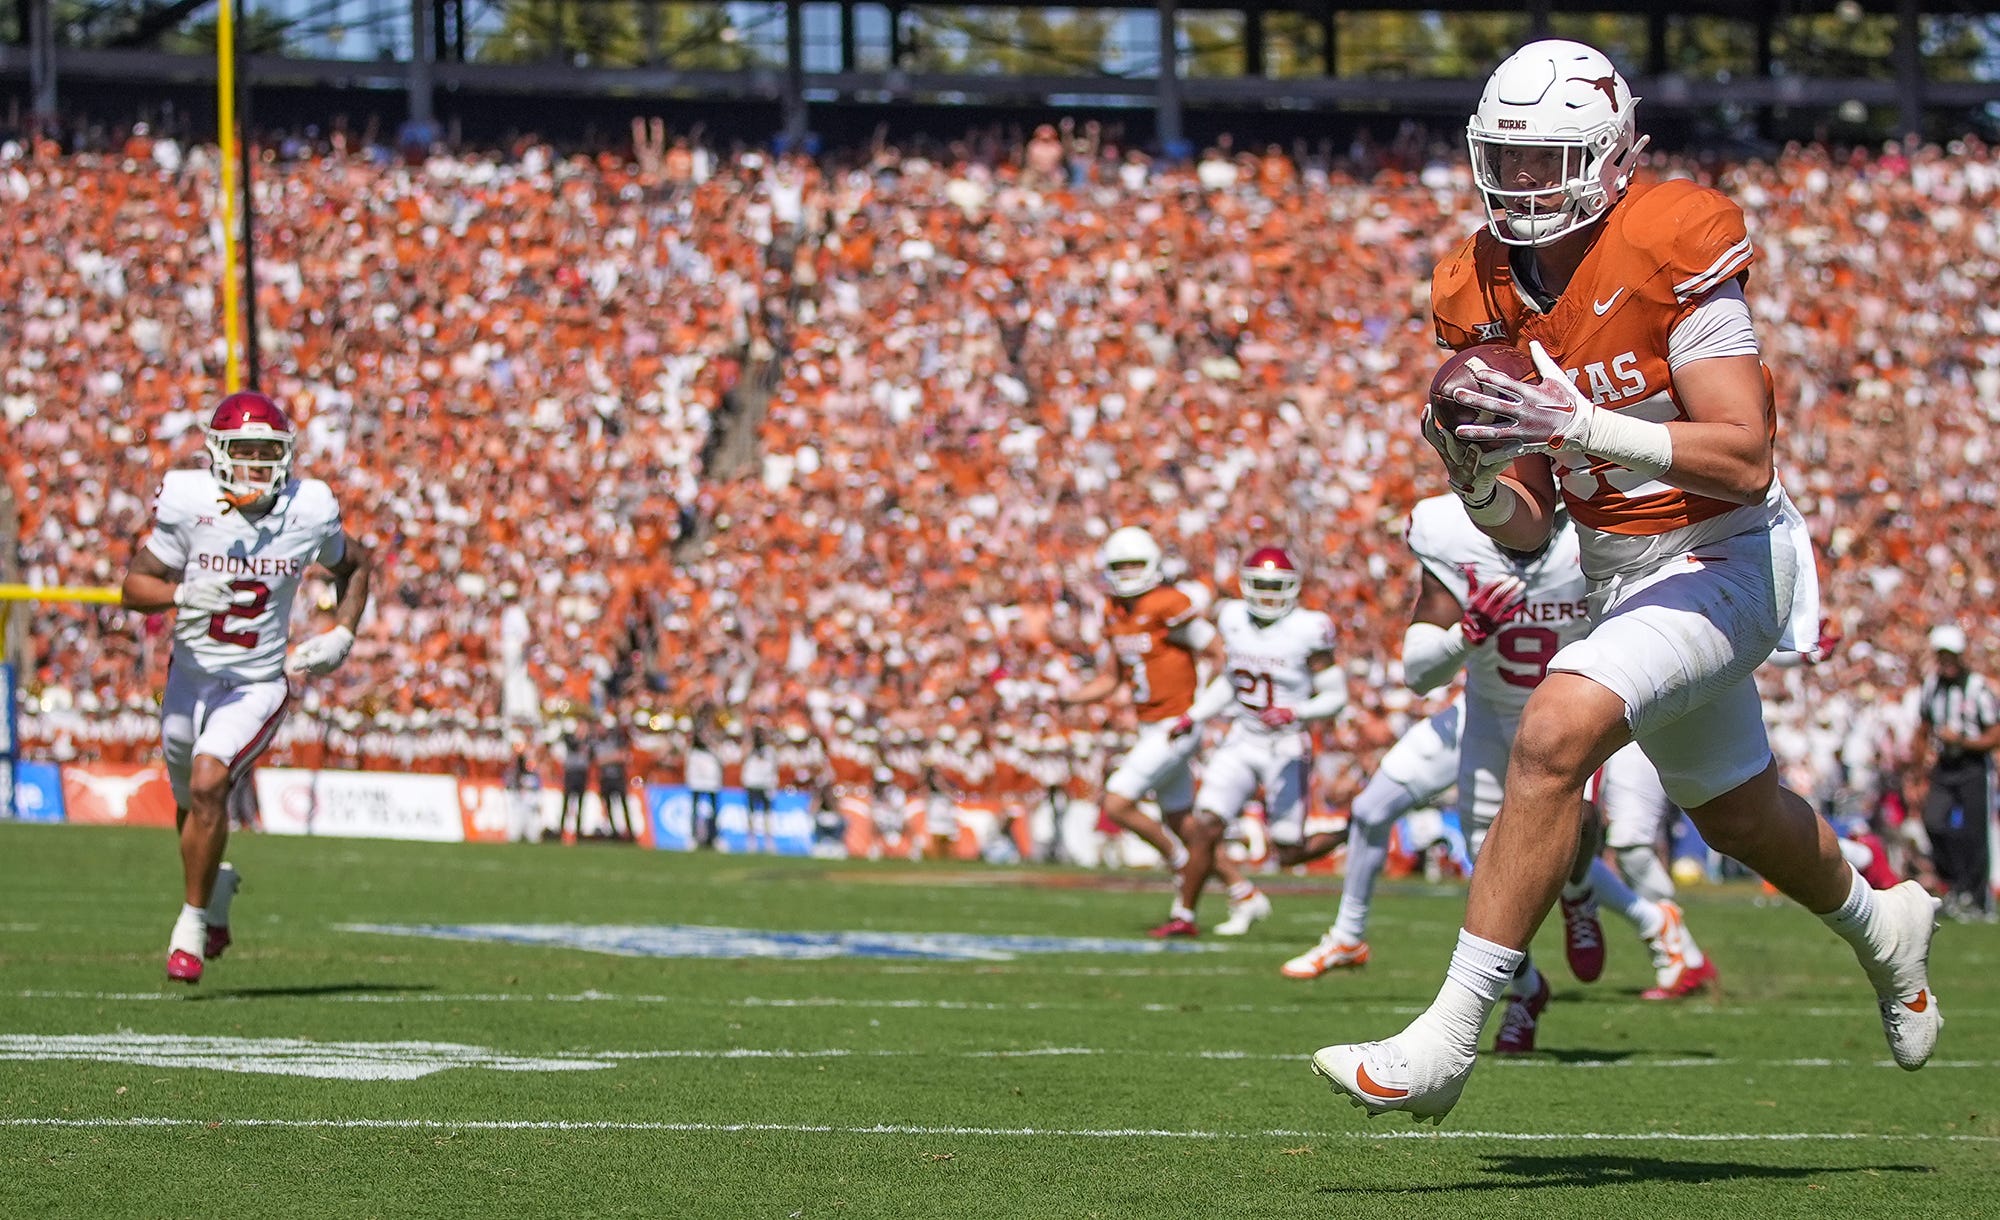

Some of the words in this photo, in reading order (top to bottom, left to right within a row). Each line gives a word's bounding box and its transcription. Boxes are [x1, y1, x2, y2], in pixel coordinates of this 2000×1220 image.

[1497, 118, 1527, 130] HORNS
[199, 553, 300, 577] SOONERS
[208, 580, 271, 649] 2
[1497, 627, 1558, 688] 9
[1232, 669, 1274, 711] 21
